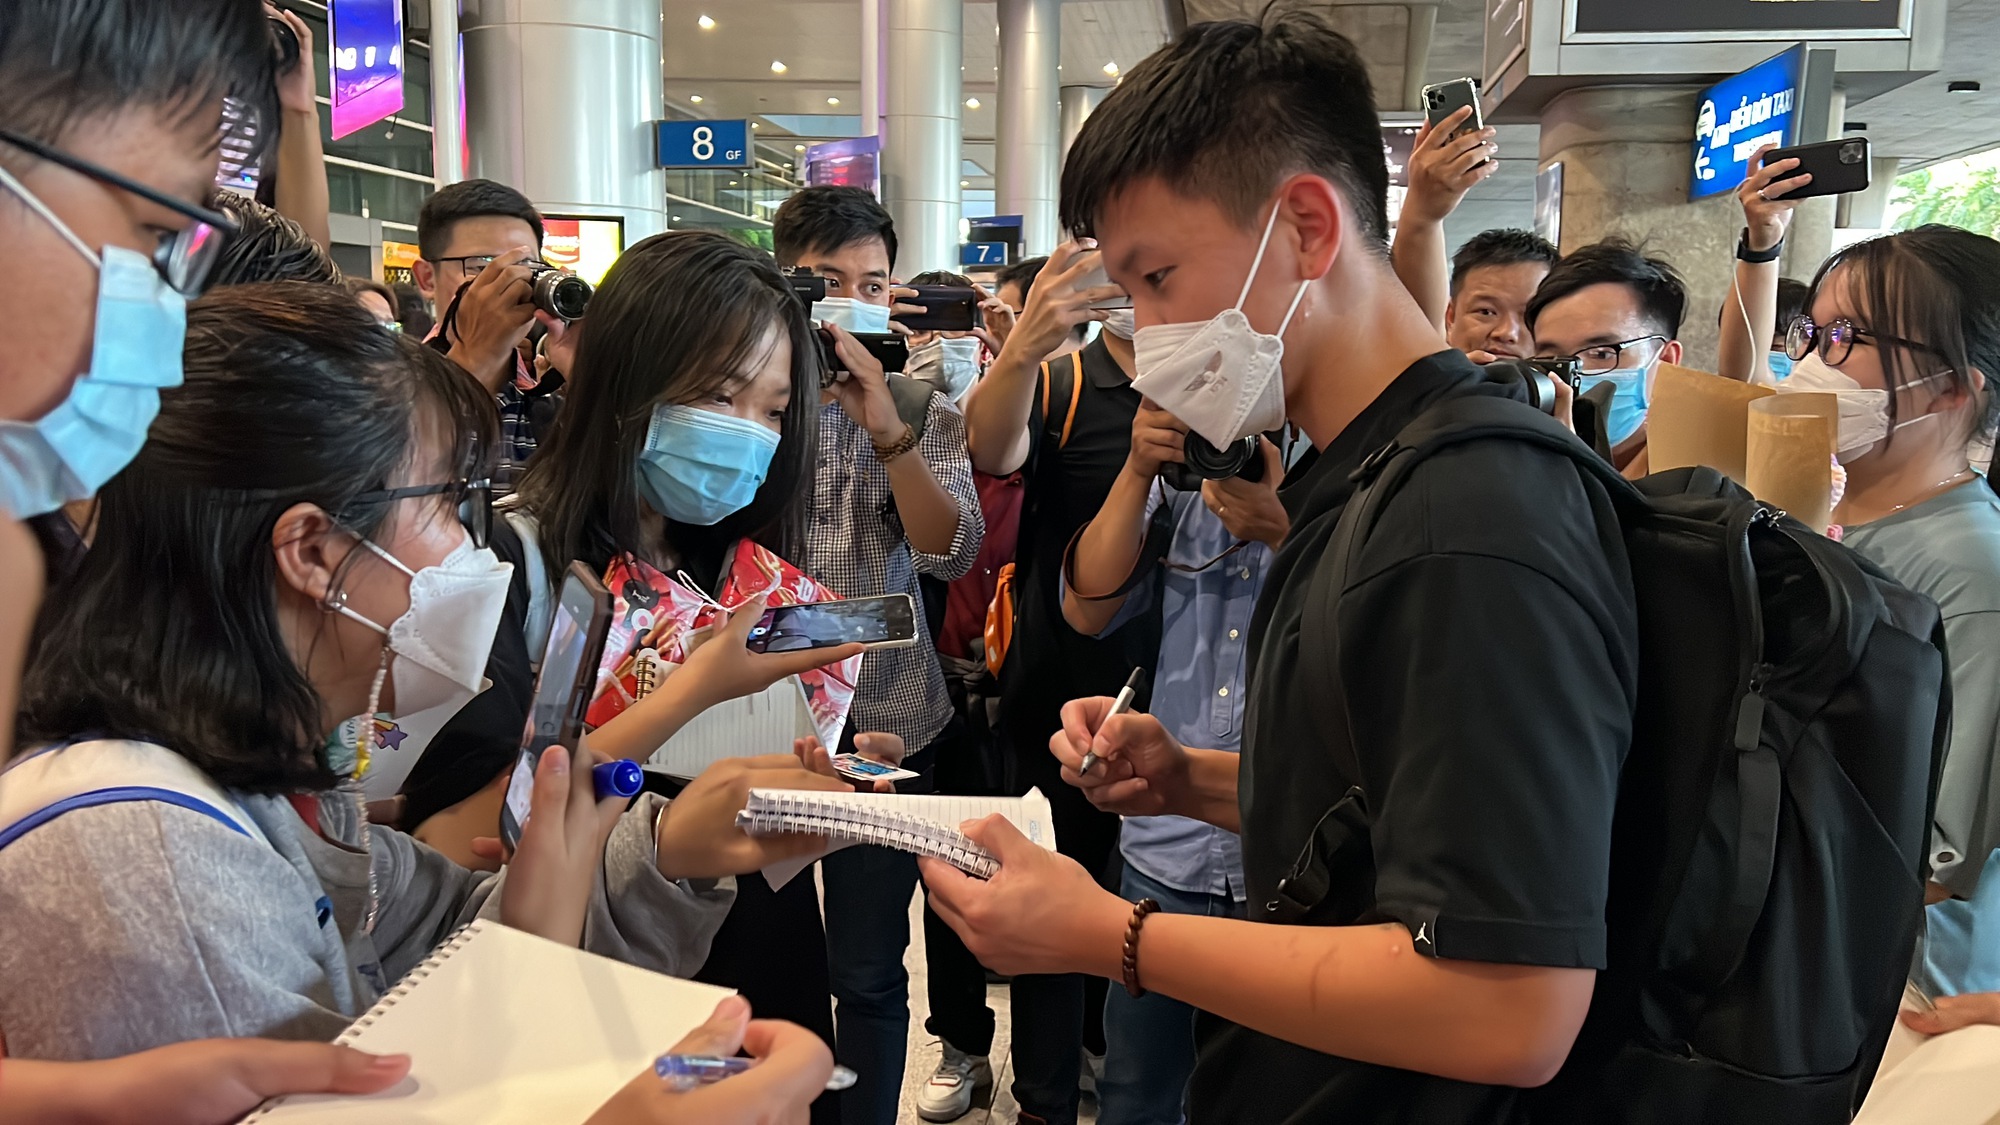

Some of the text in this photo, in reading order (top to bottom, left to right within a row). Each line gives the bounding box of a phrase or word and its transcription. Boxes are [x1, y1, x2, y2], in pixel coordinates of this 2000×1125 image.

[1773, 87, 1794, 116] TAXI
[692, 126, 714, 160] 8
[725, 150, 741, 160] GF
[977, 245, 990, 262] 7
